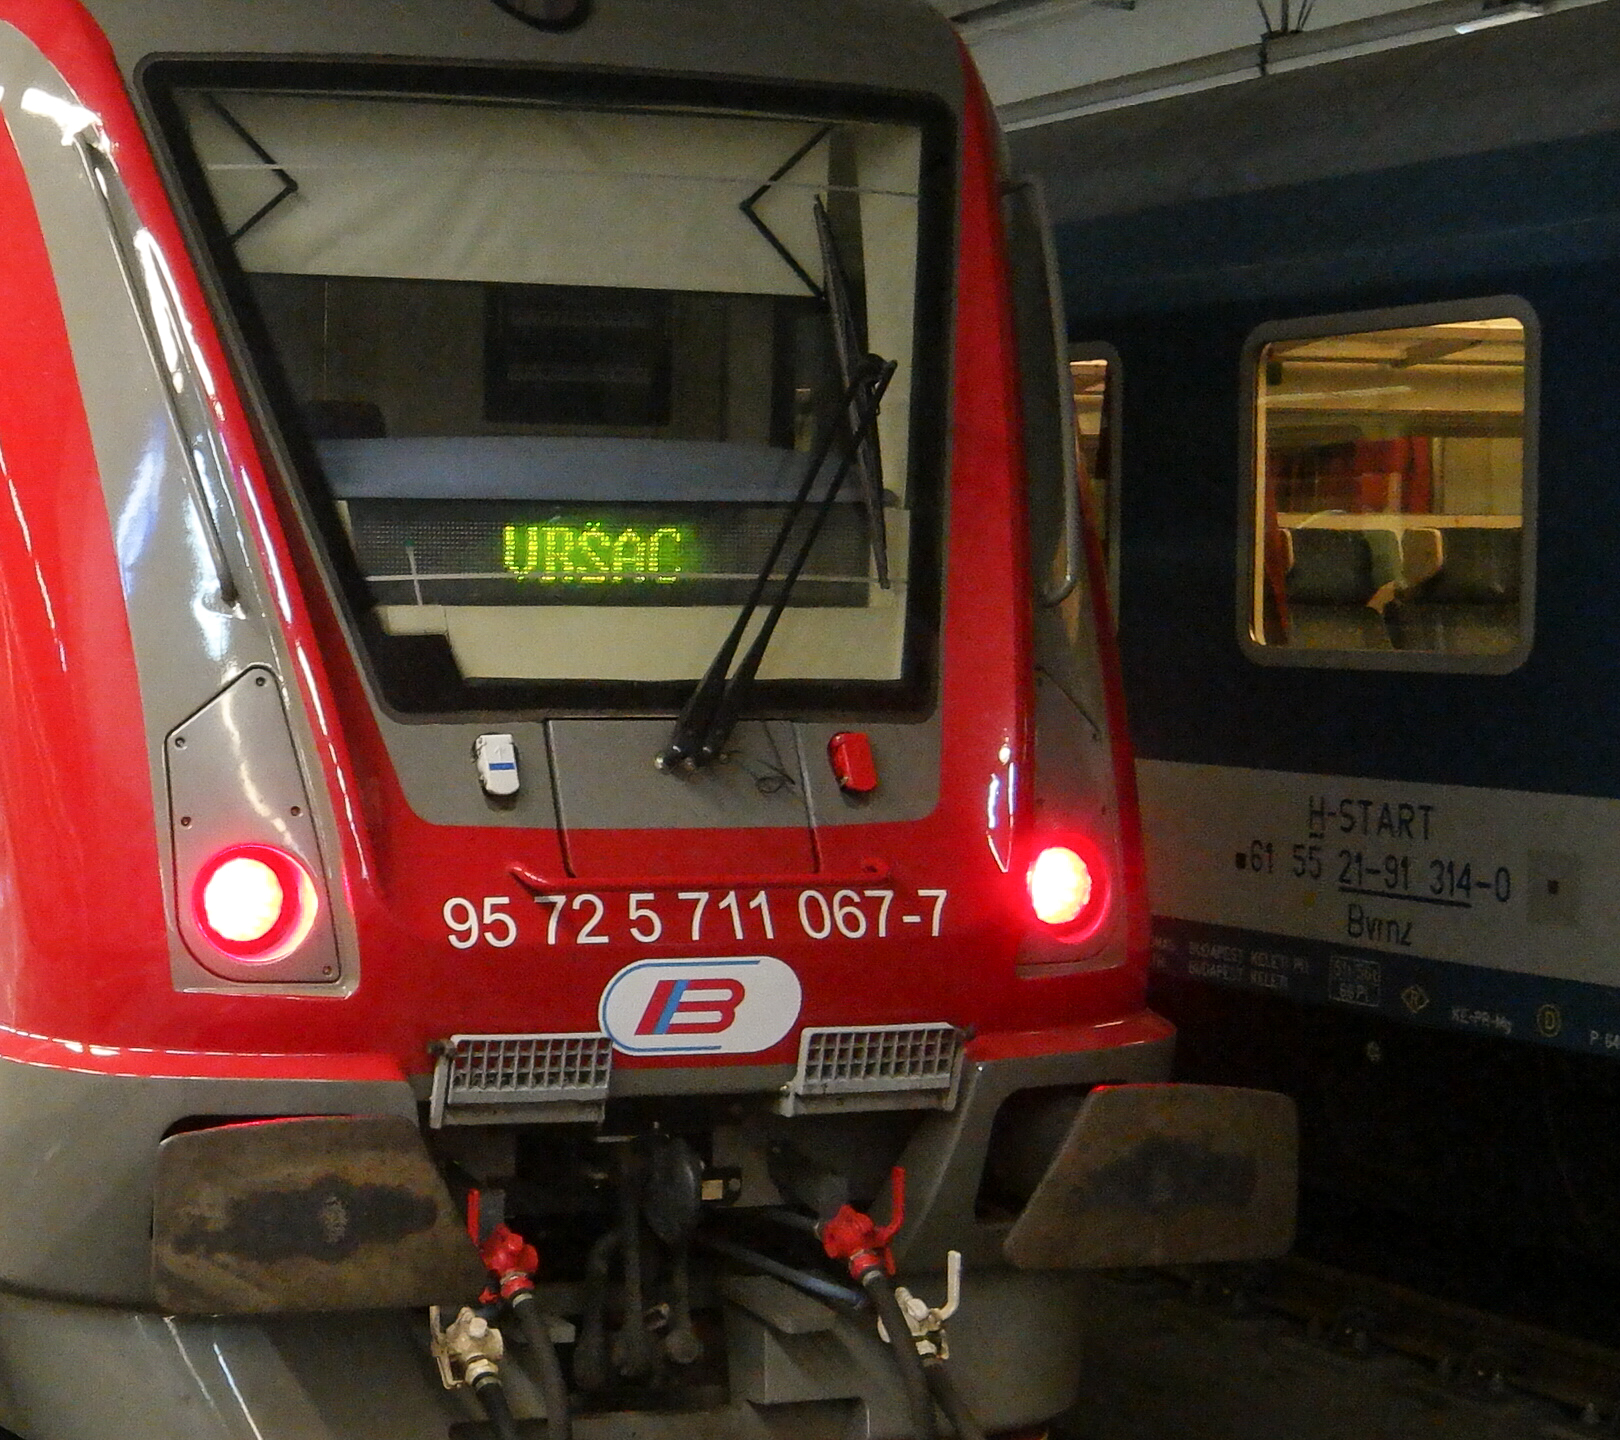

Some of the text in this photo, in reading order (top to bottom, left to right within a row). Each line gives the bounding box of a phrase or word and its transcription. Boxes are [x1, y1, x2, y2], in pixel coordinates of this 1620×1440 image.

[1309, 795, 1436, 841] H-START
[1250, 839, 1512, 904] 61 55 21-91 314-0
[442, 887, 948, 950] 95 72 5 711 067-7
